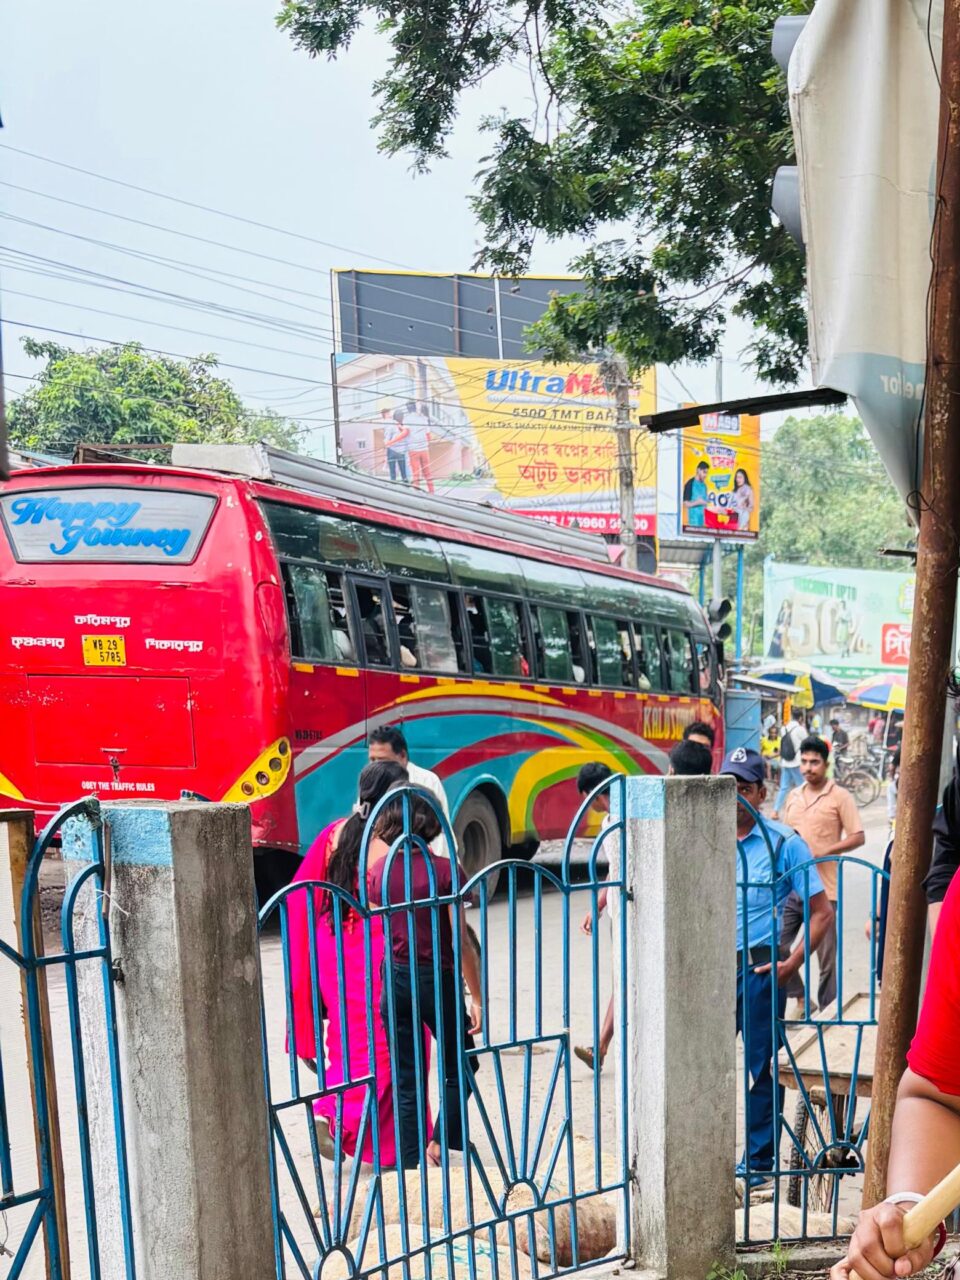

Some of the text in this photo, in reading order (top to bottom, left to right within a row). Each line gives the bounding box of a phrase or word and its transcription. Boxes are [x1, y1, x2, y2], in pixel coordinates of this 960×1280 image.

[552, 409, 581, 420] TMT
[519, 460, 558, 490] অটুট
[11, 497, 142, 527] Happy
[50, 525, 191, 556] Journey
[74, 613, 131, 628] করিমপুর
[93, 640, 118, 650] WB 29
[145, 638, 204, 652] শিকারপুর
[81, 781, 155, 792] OBEY THE TRAFFIC RULES
